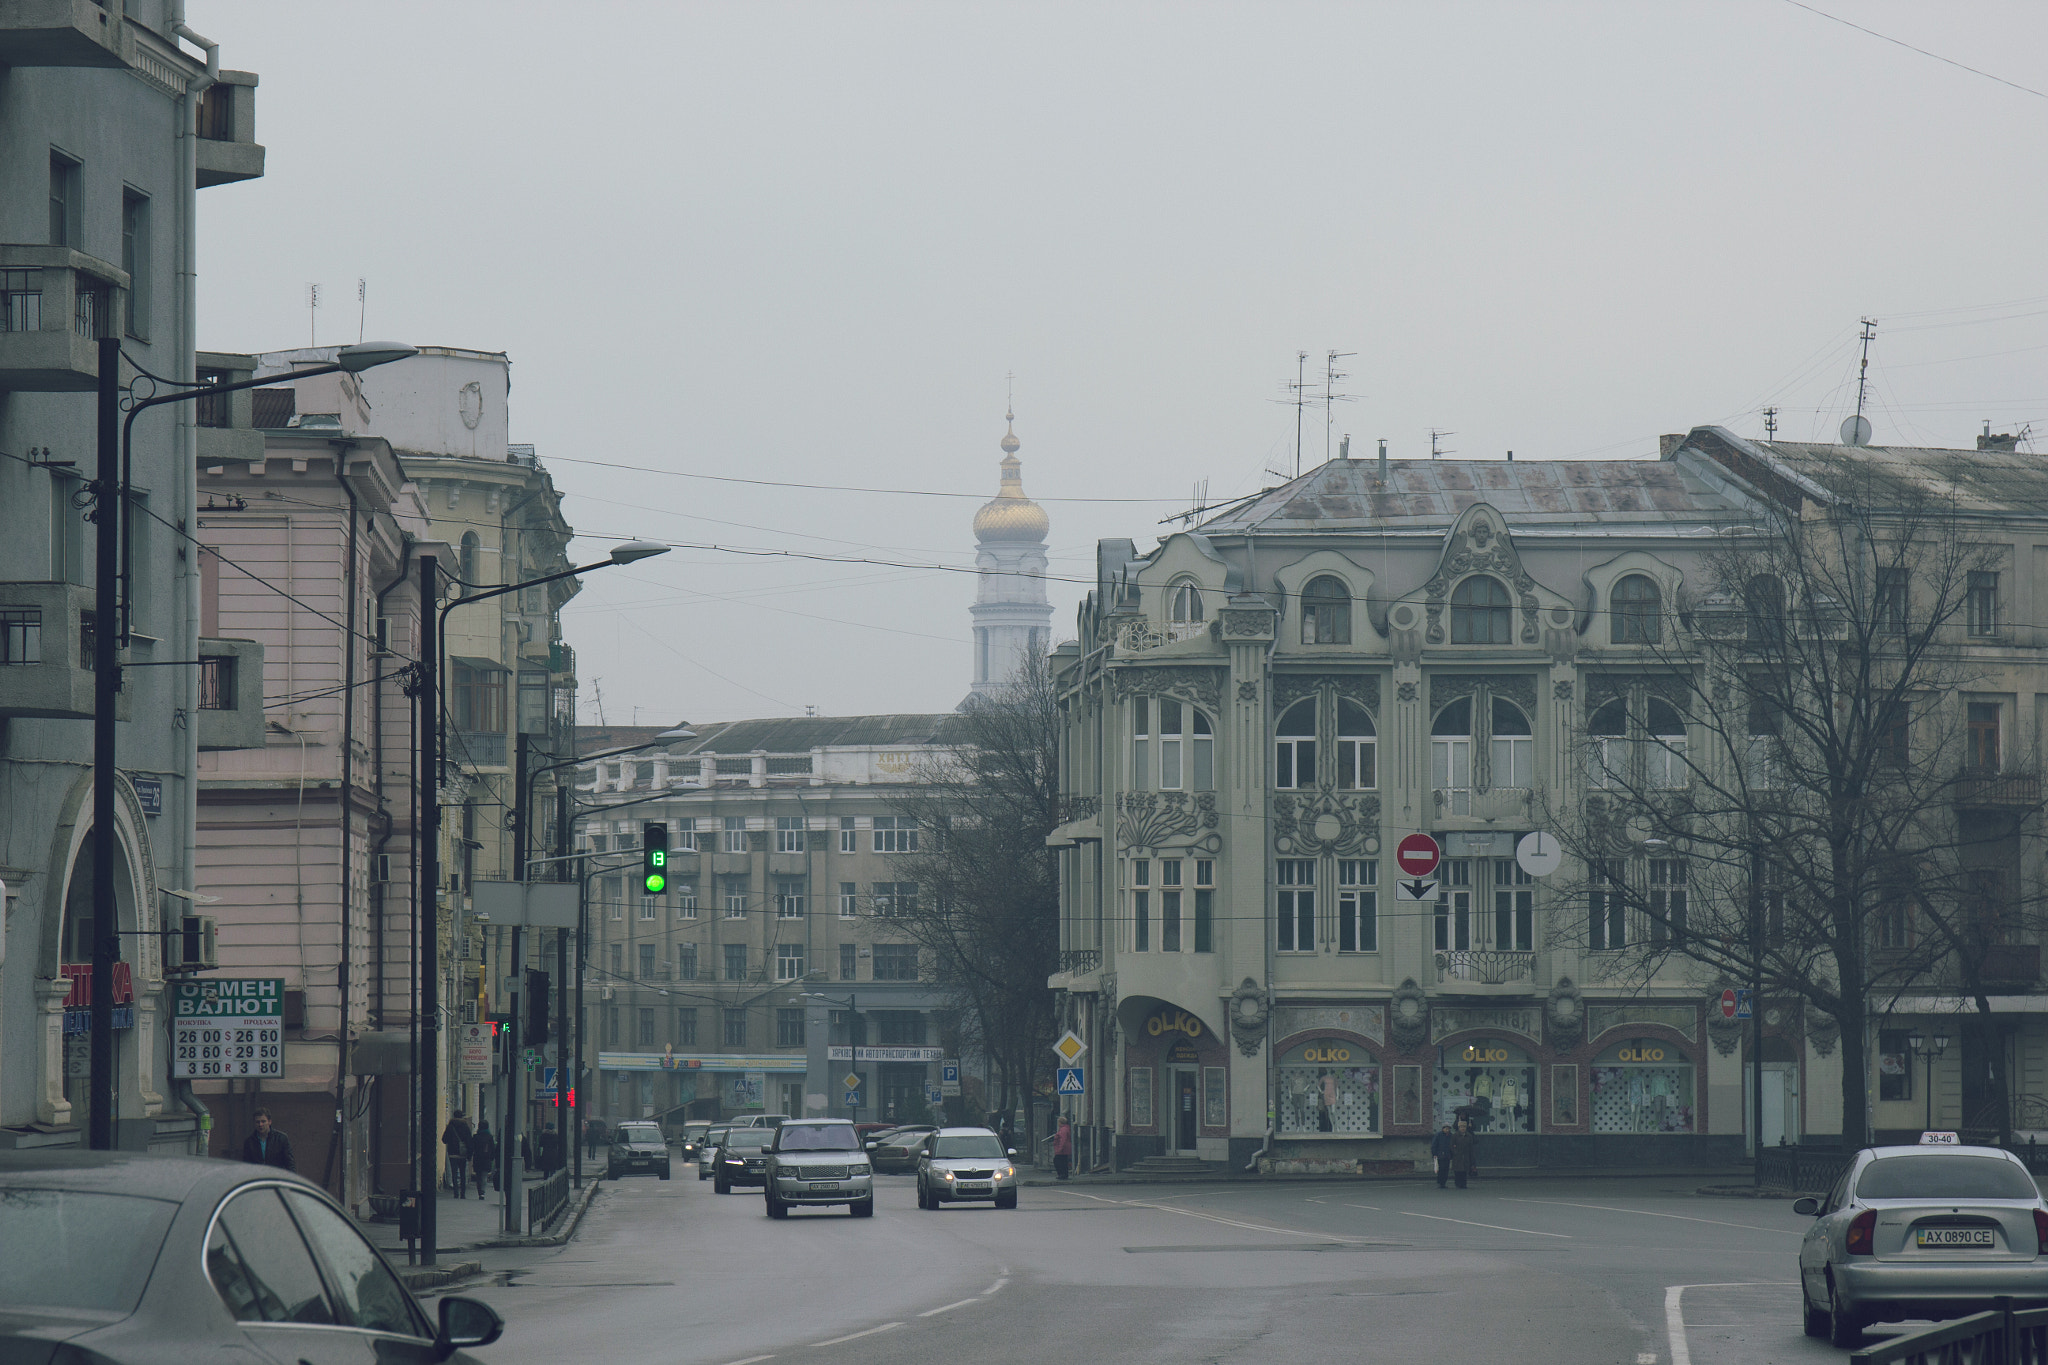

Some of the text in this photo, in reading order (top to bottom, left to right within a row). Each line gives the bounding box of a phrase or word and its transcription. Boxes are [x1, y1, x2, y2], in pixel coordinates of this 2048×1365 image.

[878, 753, 911, 762] ХАТТ
[153, 787, 160, 807] 26
[653, 852, 664, 866] 13
[60, 962, 134, 1006] ОПТКА
[180, 981, 276, 997] ОБМЕН
[178, 998, 278, 1015] ВАЛЮТ
[1148, 1011, 1201, 1037] OLKO
[179, 1031, 197, 1043] 26
[203, 1031, 221, 1043] 00
[236, 1031, 254, 1042] 26
[260, 1030, 278, 1042] 60
[179, 1046, 197, 1058] 28
[202, 1046, 220, 1058] 60
[235, 1046, 254, 1058] 29
[260, 1046, 278, 1057] 50
[1304, 1048, 1350, 1062] OLKO
[1462, 1048, 1508, 1062] OLKO
[1618, 1048, 1664, 1062] OLKO
[188, 1062, 278, 1074] 3 50 R 3 80
[1928, 1135, 1952, 1143] 30-40
[1926, 1231, 1943, 1243] AX
[1944, 1231, 1972, 1243] 0890
[1974, 1231, 1991, 1243] CE
